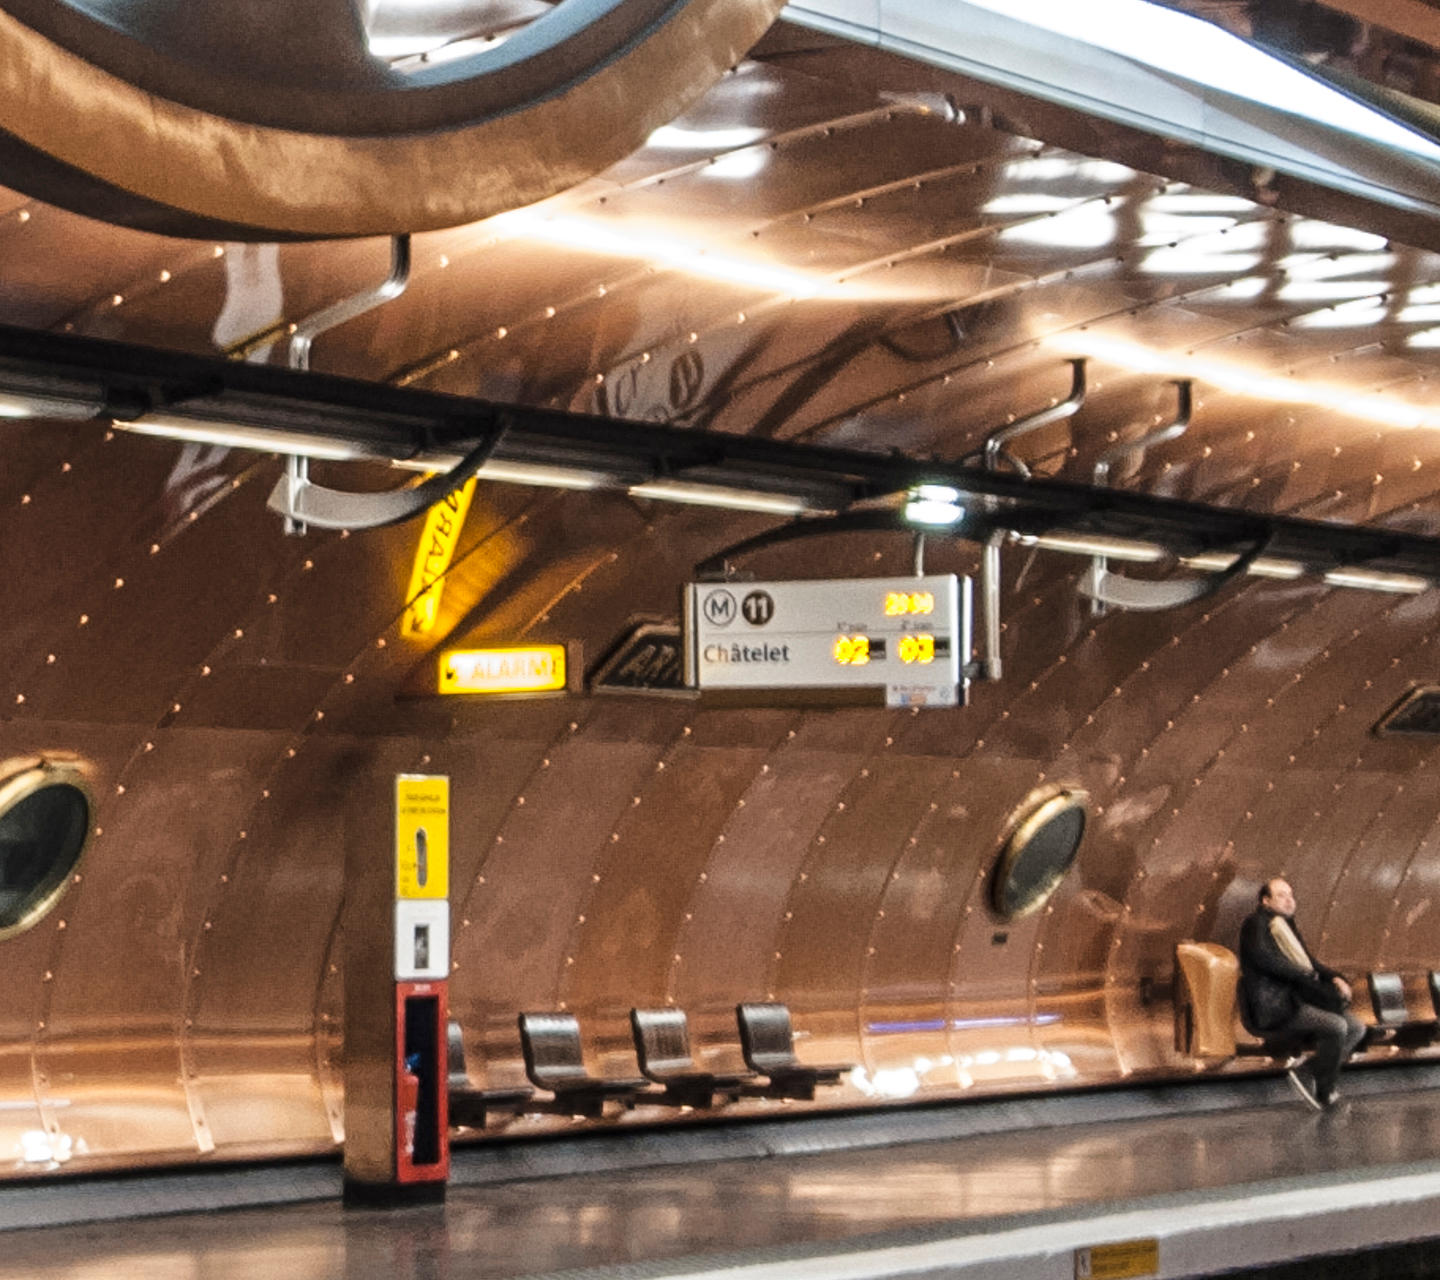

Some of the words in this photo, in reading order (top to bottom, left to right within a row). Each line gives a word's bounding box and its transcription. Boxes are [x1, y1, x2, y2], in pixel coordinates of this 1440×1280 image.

[743, 596, 770, 620] 11
[704, 642, 790, 664] Châtelet
[833, 634, 870, 666] 02
